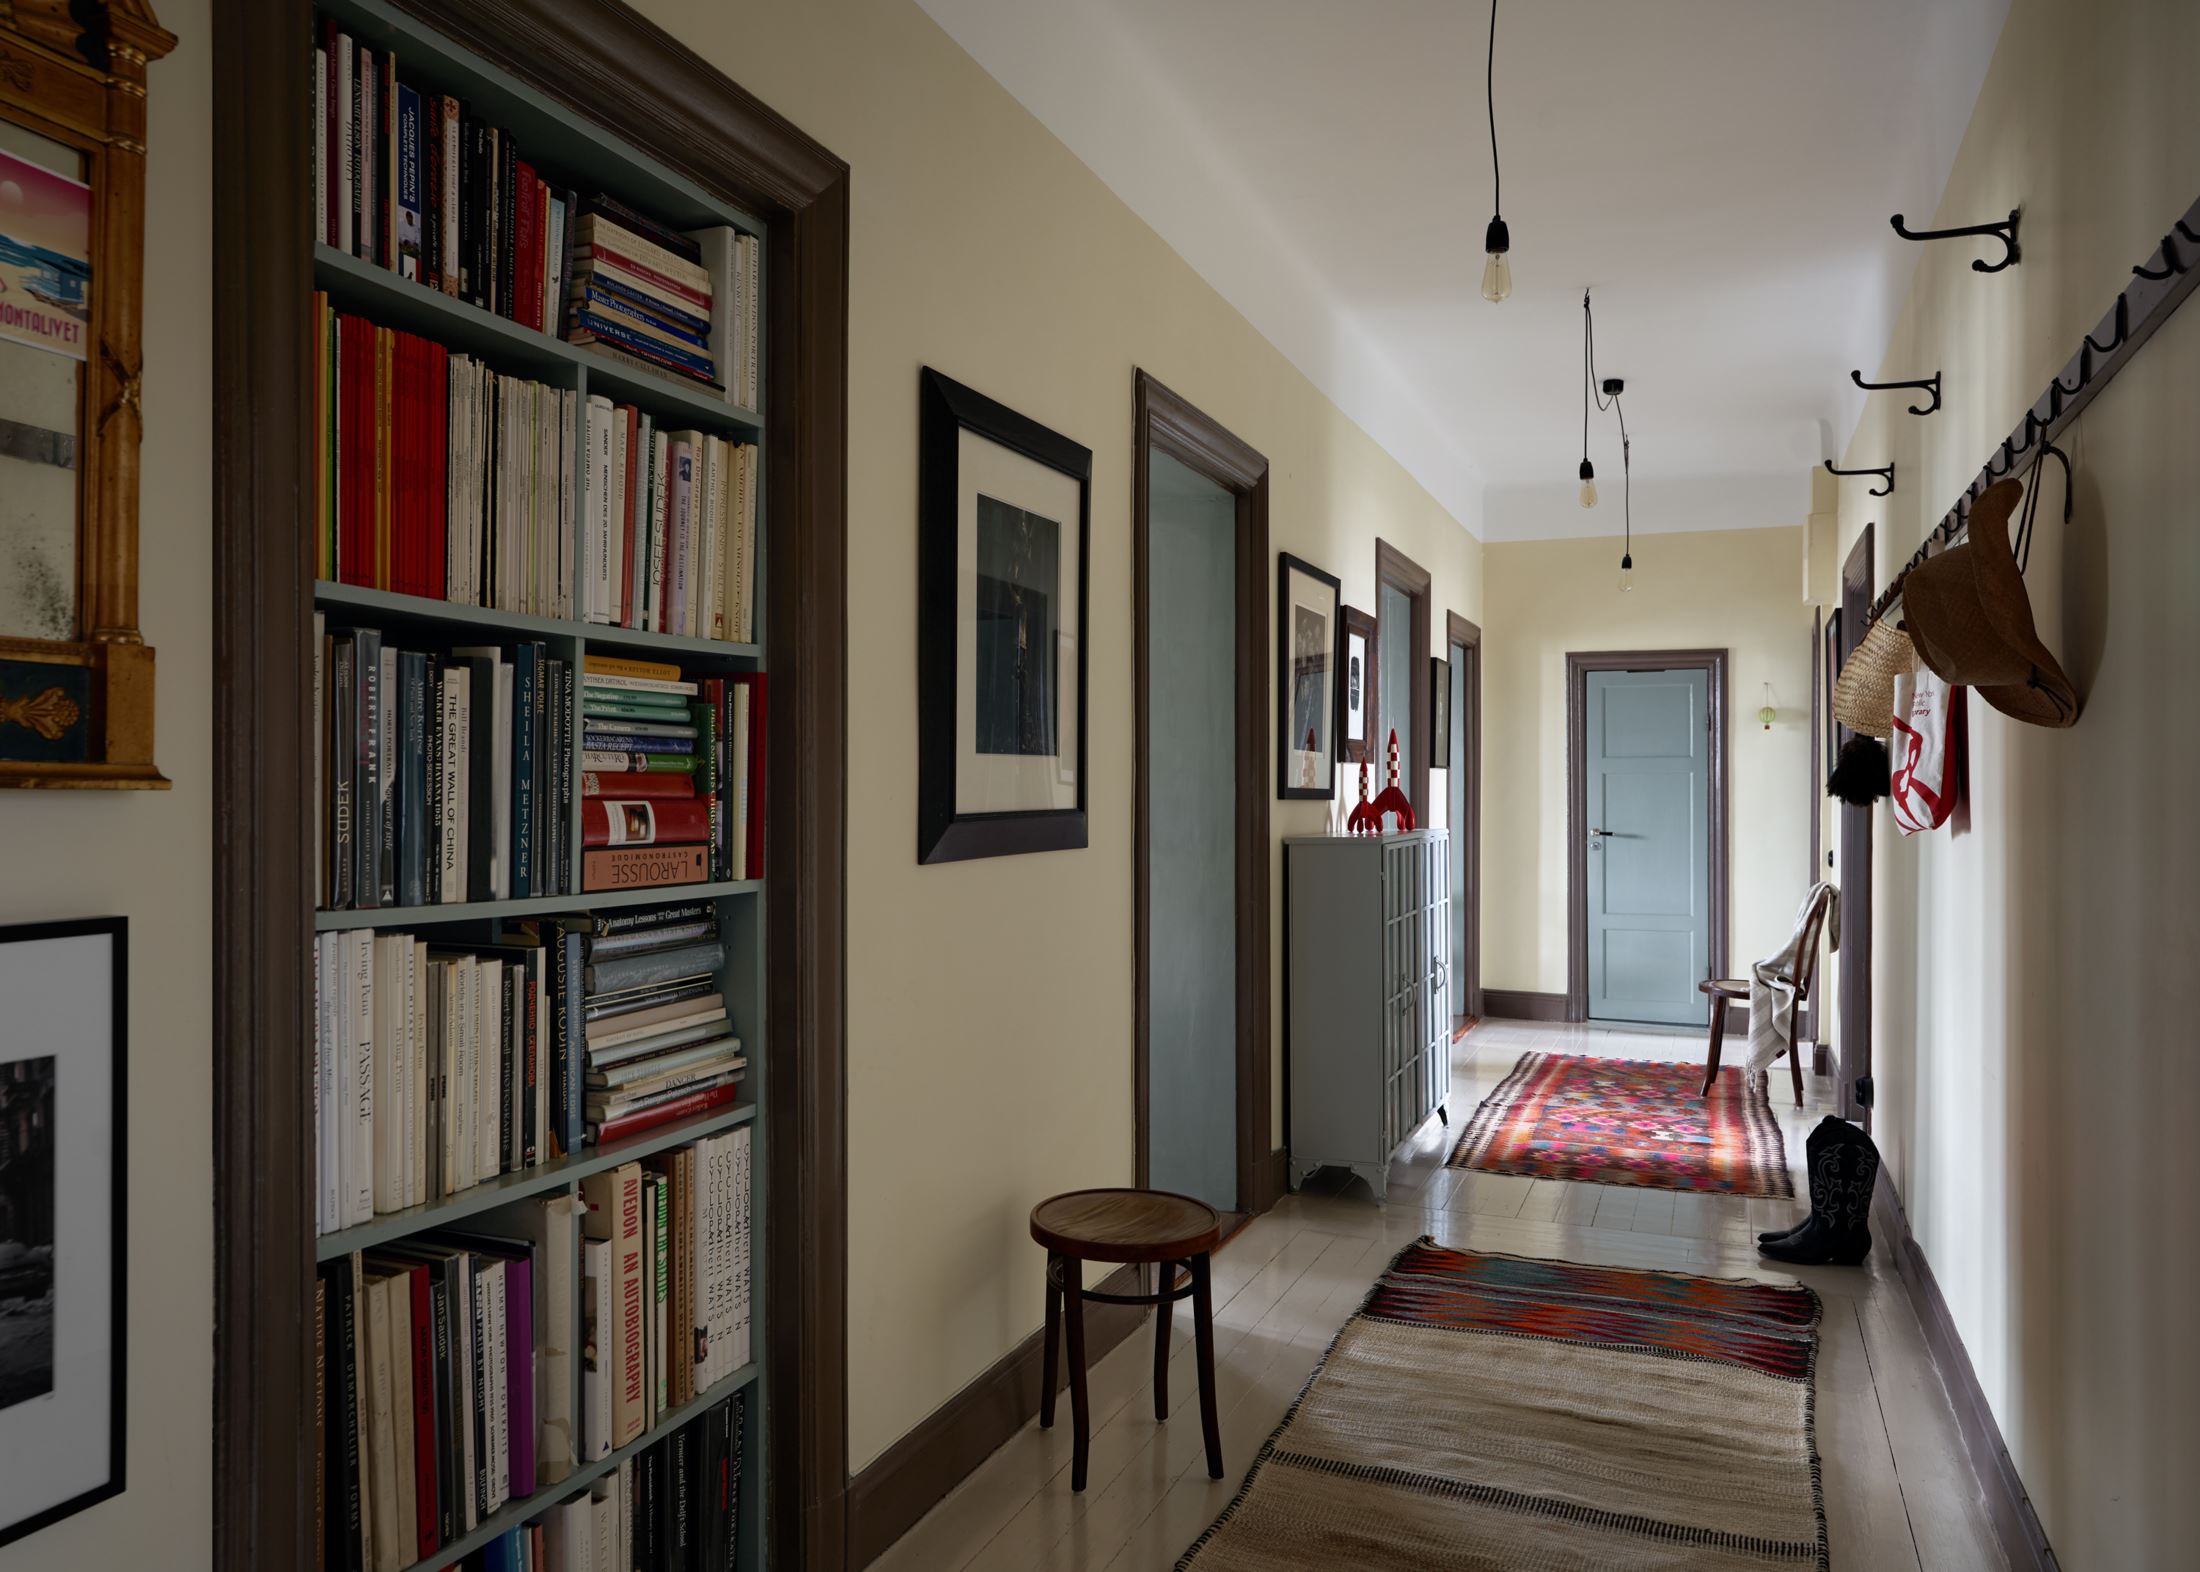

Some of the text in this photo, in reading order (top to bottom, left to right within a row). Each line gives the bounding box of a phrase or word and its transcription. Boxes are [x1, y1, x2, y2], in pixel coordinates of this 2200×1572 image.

[353, 120, 362, 150] OLSON
[408, 105, 417, 204] JACQUES PEPIN'S
[353, 153, 362, 214] FOTOGRAFIER
[587, 318, 632, 341] UNIVERSE
[655, 473, 665, 533] SUDEK
[719, 480, 727, 557] IMPRESSIONIST
[536, 658, 545, 716] SIGMAR POLKE
[368, 665, 377, 784] ROBERT FRANK
[448, 722, 456, 767] GREAT
[561, 668, 572, 804] TINA MODOTTI: Photographs
[447, 770, 456, 805] WALL
[520, 676, 531, 878] SHEILA METZNER
[337, 780, 350, 844] SUDEK
[383, 821, 393, 830] of
[447, 807, 455, 825] OF
[384, 830, 393, 850] style
[446, 827, 454, 871] CHINA
[611, 860, 688, 884] LAROUSSE
[607, 905, 703, 928] Anatomy Lessons Great Masters
[457, 968, 466, 998] Worlds
[557, 926, 567, 1000] AUGUSTE
[324, 1014, 332, 1033] work
[457, 1000, 466, 1009] in
[324, 1035, 333, 1044] of
[357, 941, 371, 1126] Irving Penn PASSAGE
[416, 1012, 424, 1043] Irving
[457, 1023, 466, 1048] Small
[558, 1007, 567, 1061] RODIN
[394, 1027, 403, 1094] Irving Penn
[457, 1050, 466, 1077] Room
[502, 979, 512, 1152] Robert Maxwell PHOTOGRAPHS
[527, 1034, 536, 1088] СТЕПАНОВА
[665, 1074, 697, 1090] DANCER
[656, 1183, 668, 1304] AVEDON THE SIXTIES
[622, 1179, 641, 1404] AVEDON AN AUTOBIOGRAPHY
[437, 1318, 446, 1360] Saudek
[476, 1358, 484, 1372] BY
[344, 1295, 359, 1531] PATRICK DEMARCHELIER FORMS
[678, 1432, 686, 1467] Vermeer
[677, 1499, 687, 1521] Delft
